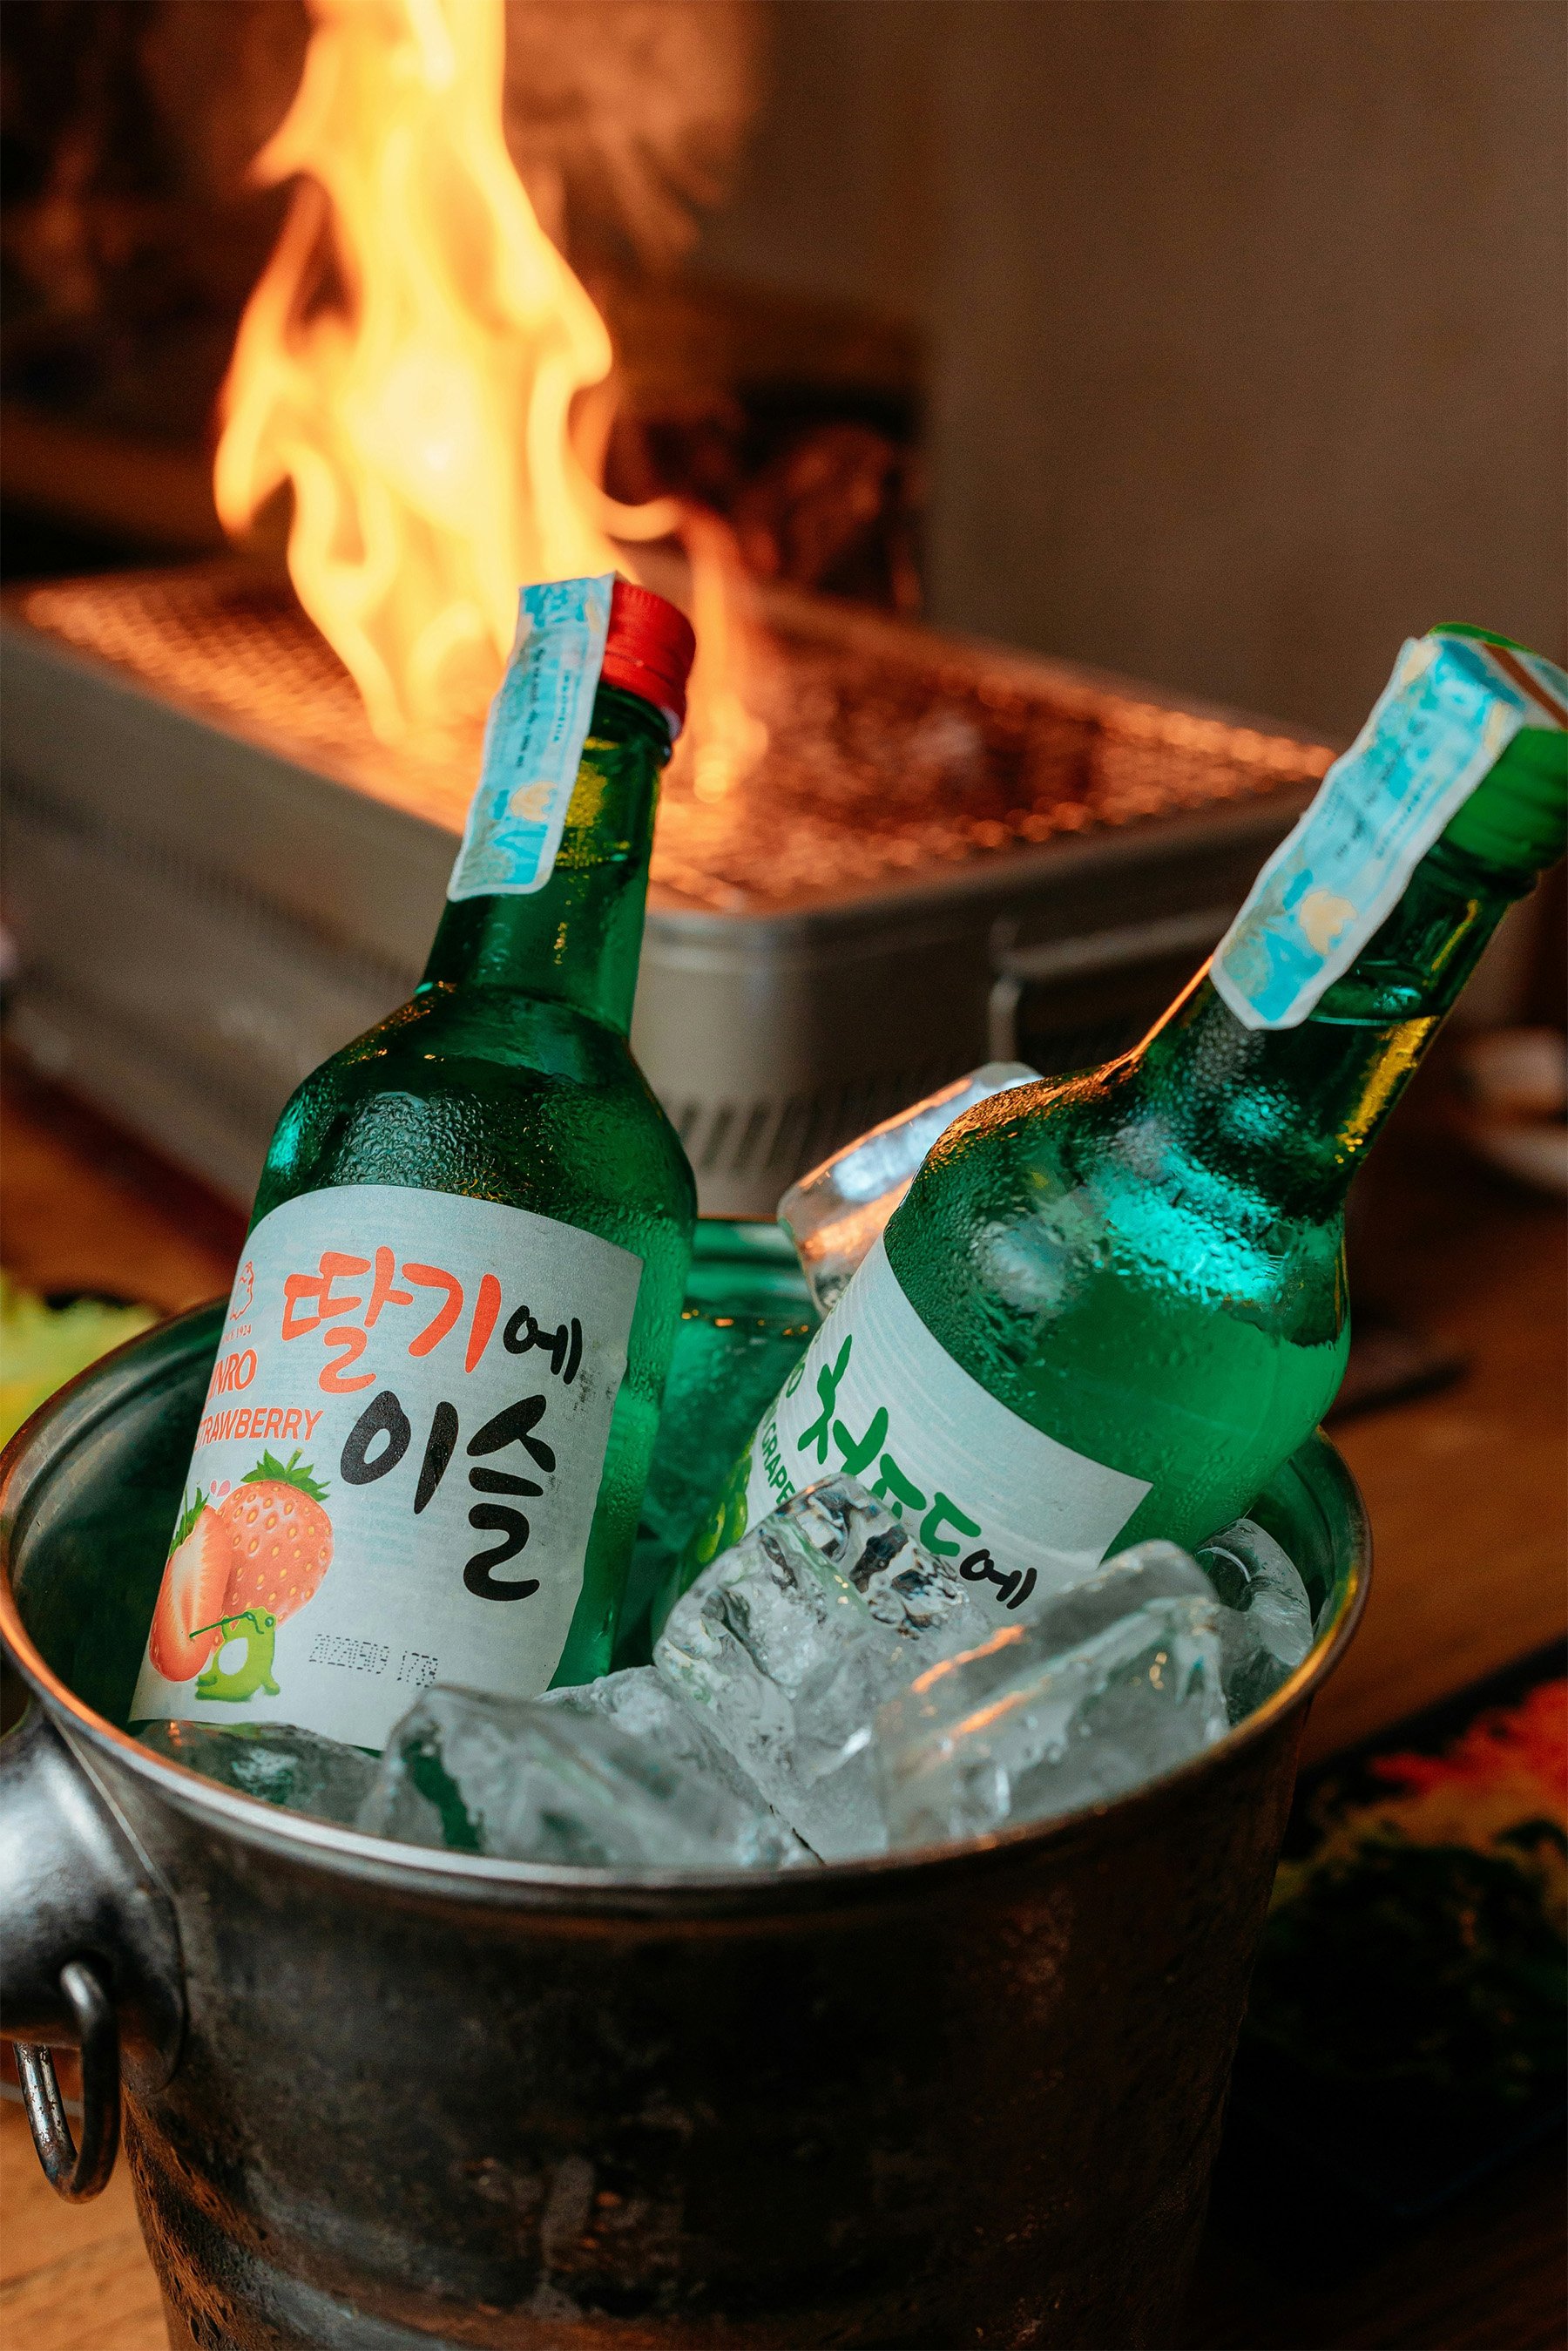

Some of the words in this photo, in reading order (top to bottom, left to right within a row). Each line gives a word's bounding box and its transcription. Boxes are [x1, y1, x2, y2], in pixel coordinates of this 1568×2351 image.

[201, 1349, 257, 1413] INRO
[281, 1245, 584, 1394] 딸기에
[340, 1390, 557, 1602] 이슬
